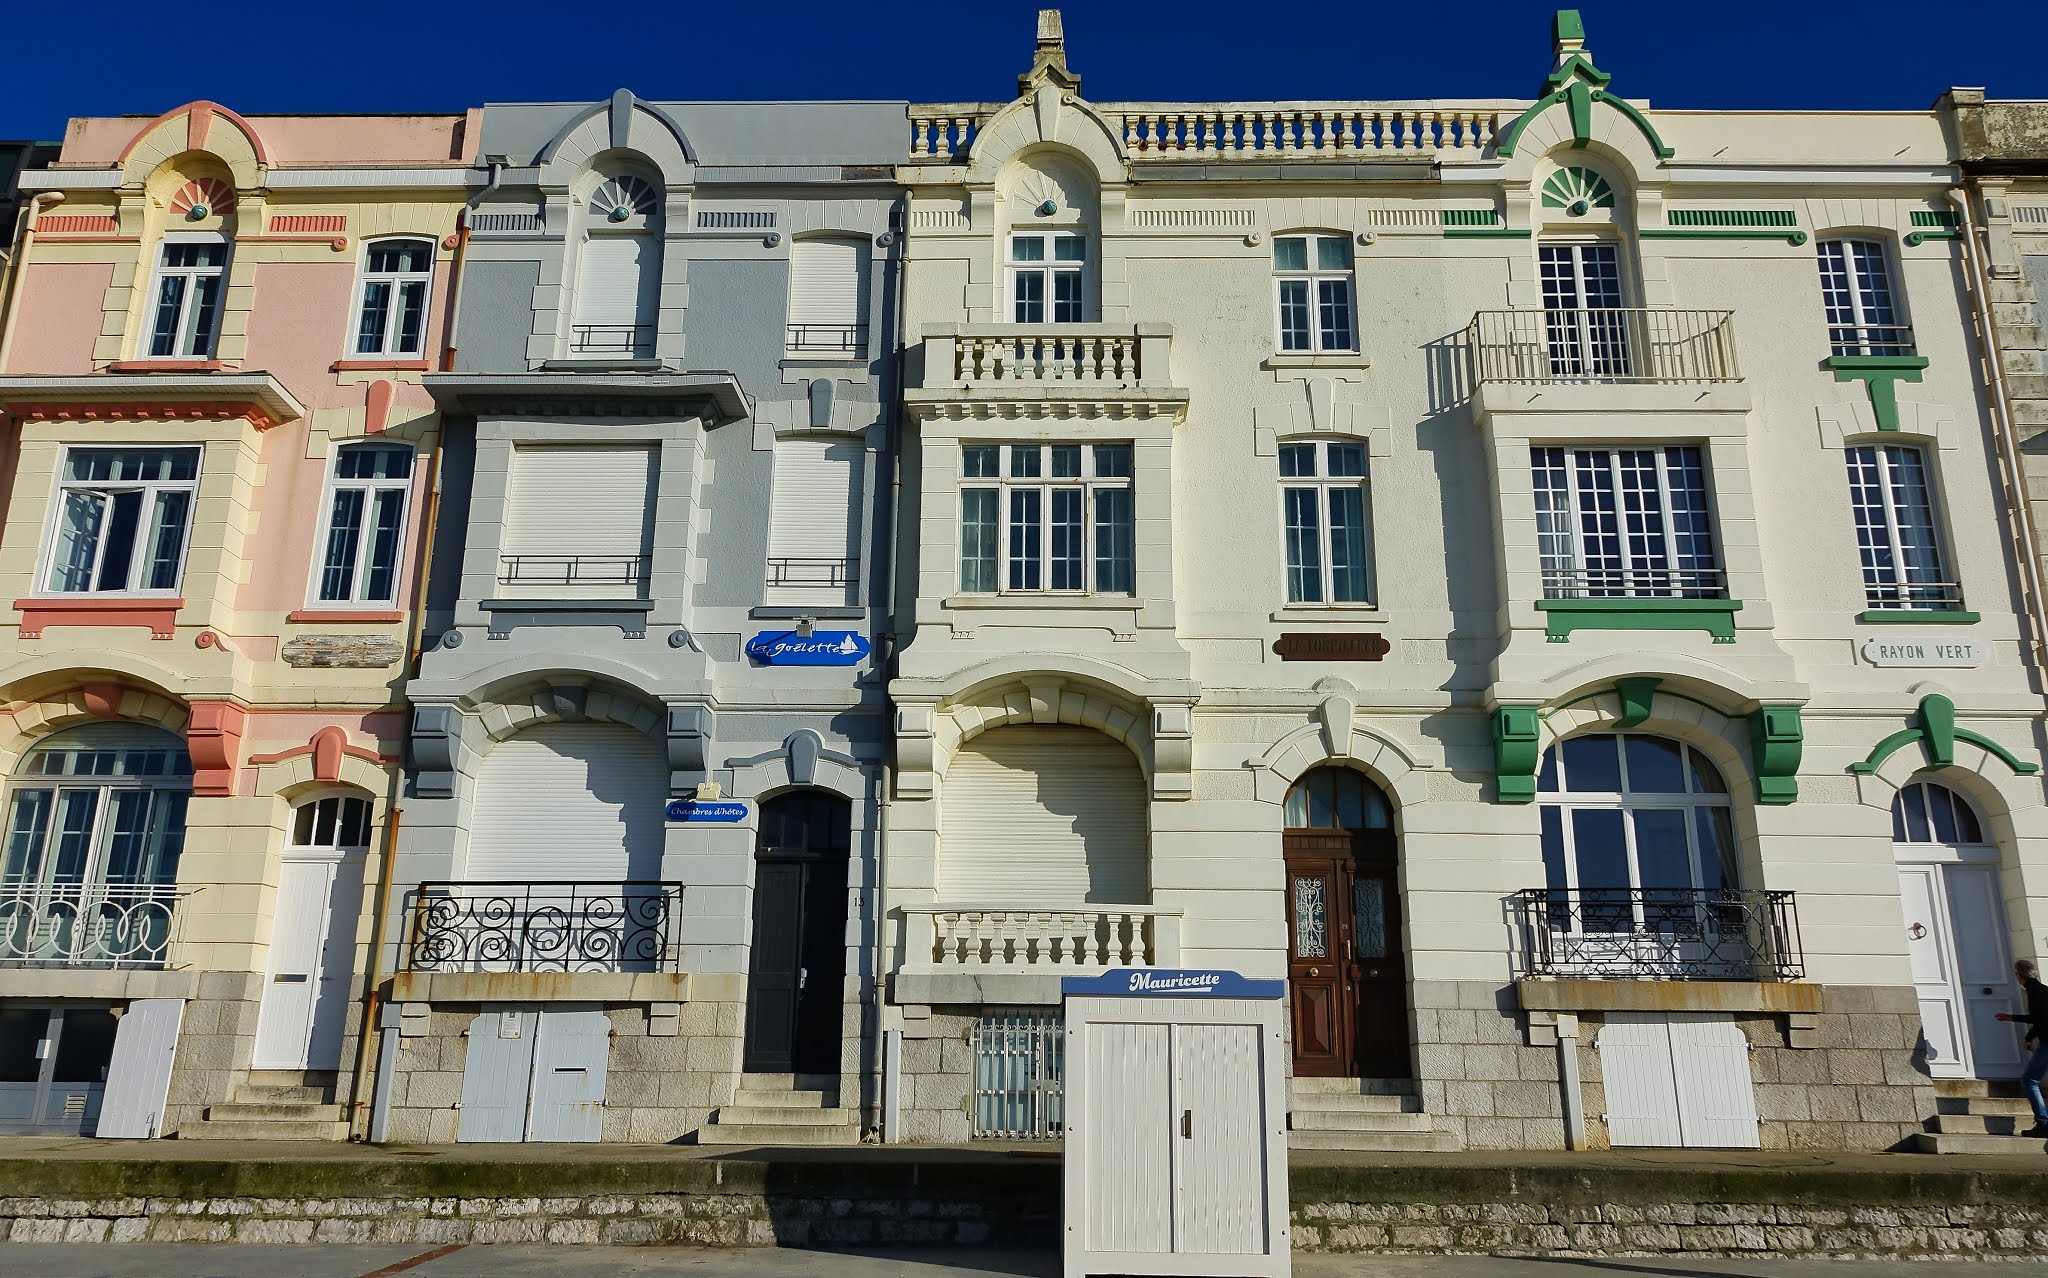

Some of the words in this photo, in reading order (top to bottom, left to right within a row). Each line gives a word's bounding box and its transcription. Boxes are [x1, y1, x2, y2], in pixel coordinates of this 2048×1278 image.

[1880, 645, 1925, 659] RAYON
[1936, 645, 1973, 659] VERT
[671, 807, 713, 816] Chambres
[853, 896, 865, 907] 13
[1129, 972, 1220, 992] Mauricette
